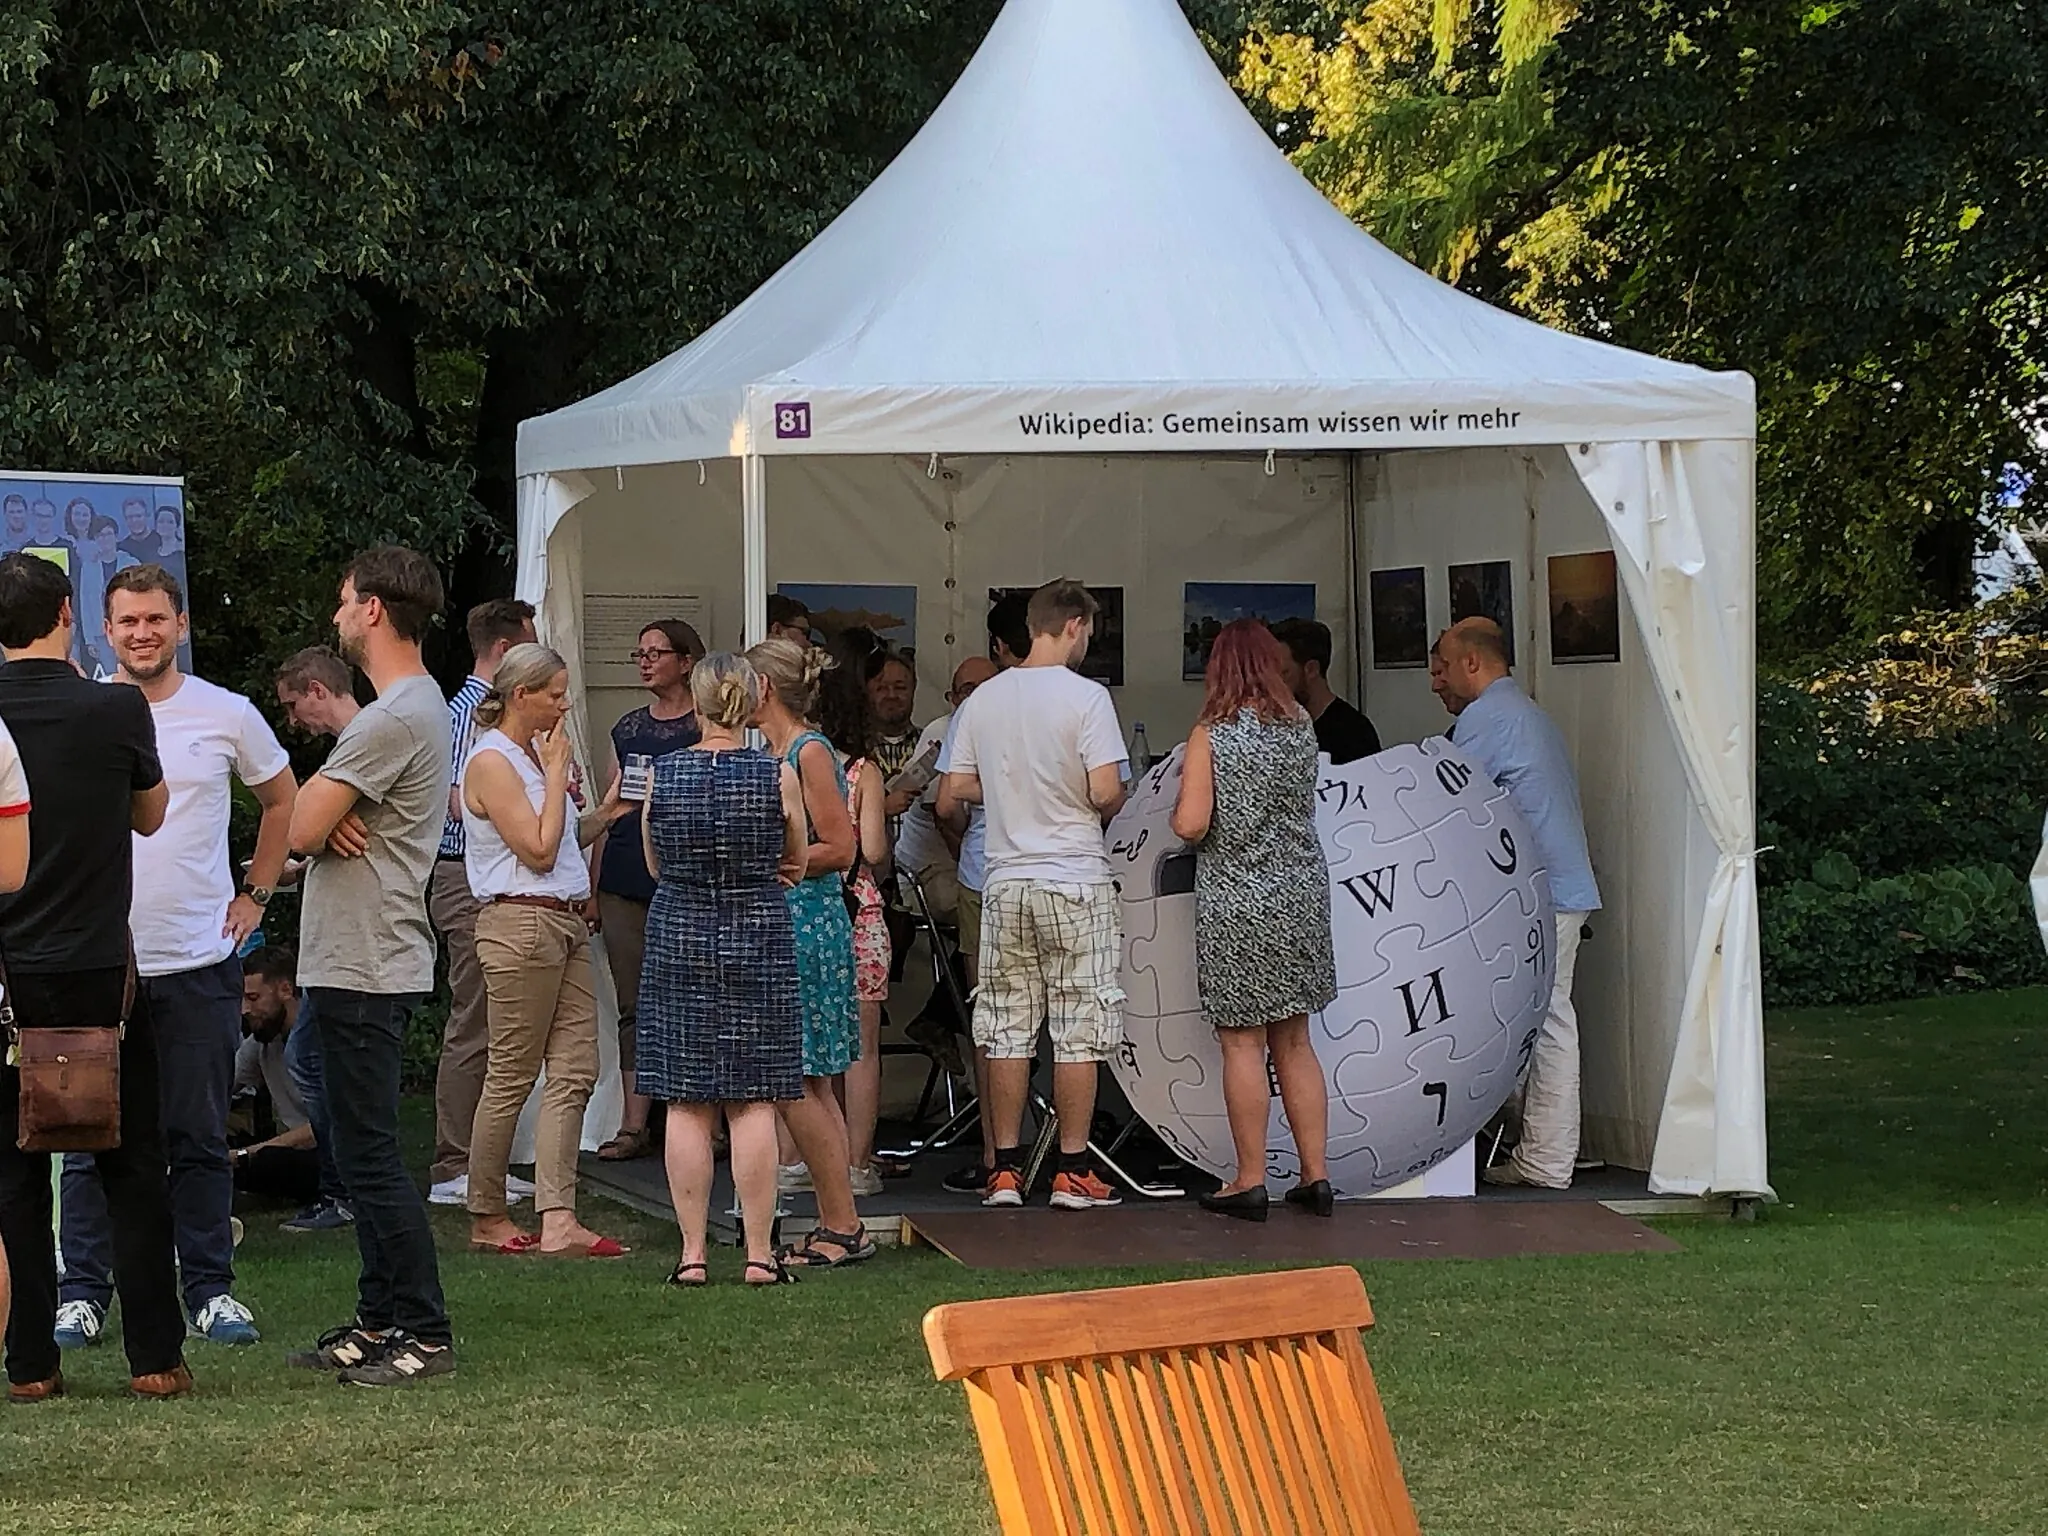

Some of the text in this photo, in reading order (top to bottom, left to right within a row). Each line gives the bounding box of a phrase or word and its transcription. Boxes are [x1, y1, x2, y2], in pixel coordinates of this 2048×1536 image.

[779, 408, 807, 432] 81
[1019, 407, 1522, 439] Wikipedia: Gemeinsam wissen wir mehr
[1336, 862, 1400, 919] W
[1392, 966, 1456, 1038] И
[333, 1341, 363, 1366] N
[392, 1352, 426, 1376] N
